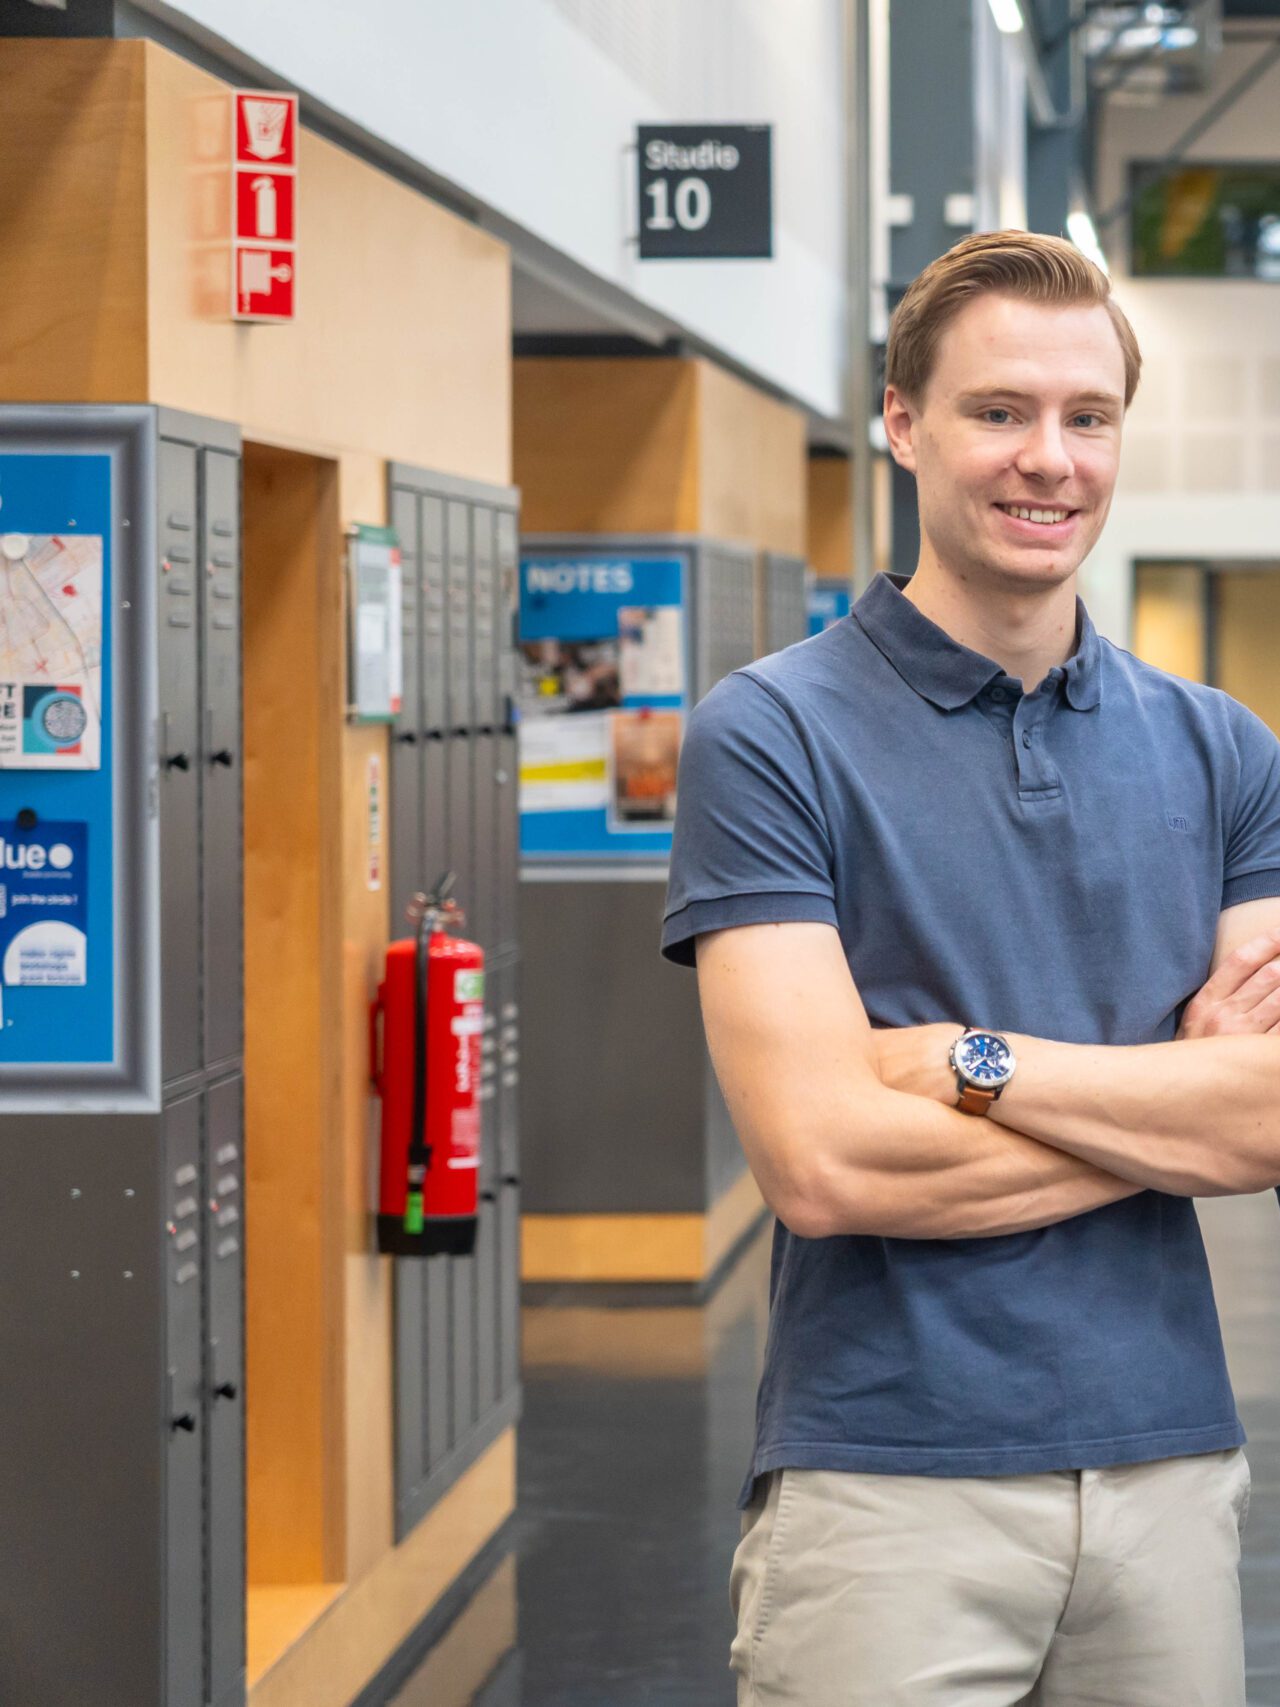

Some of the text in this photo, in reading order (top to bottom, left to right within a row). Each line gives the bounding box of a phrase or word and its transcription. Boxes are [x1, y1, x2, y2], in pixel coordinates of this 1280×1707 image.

[645, 139, 740, 170] Studio
[645, 177, 711, 231] 10
[526, 562, 634, 594] NOTES
